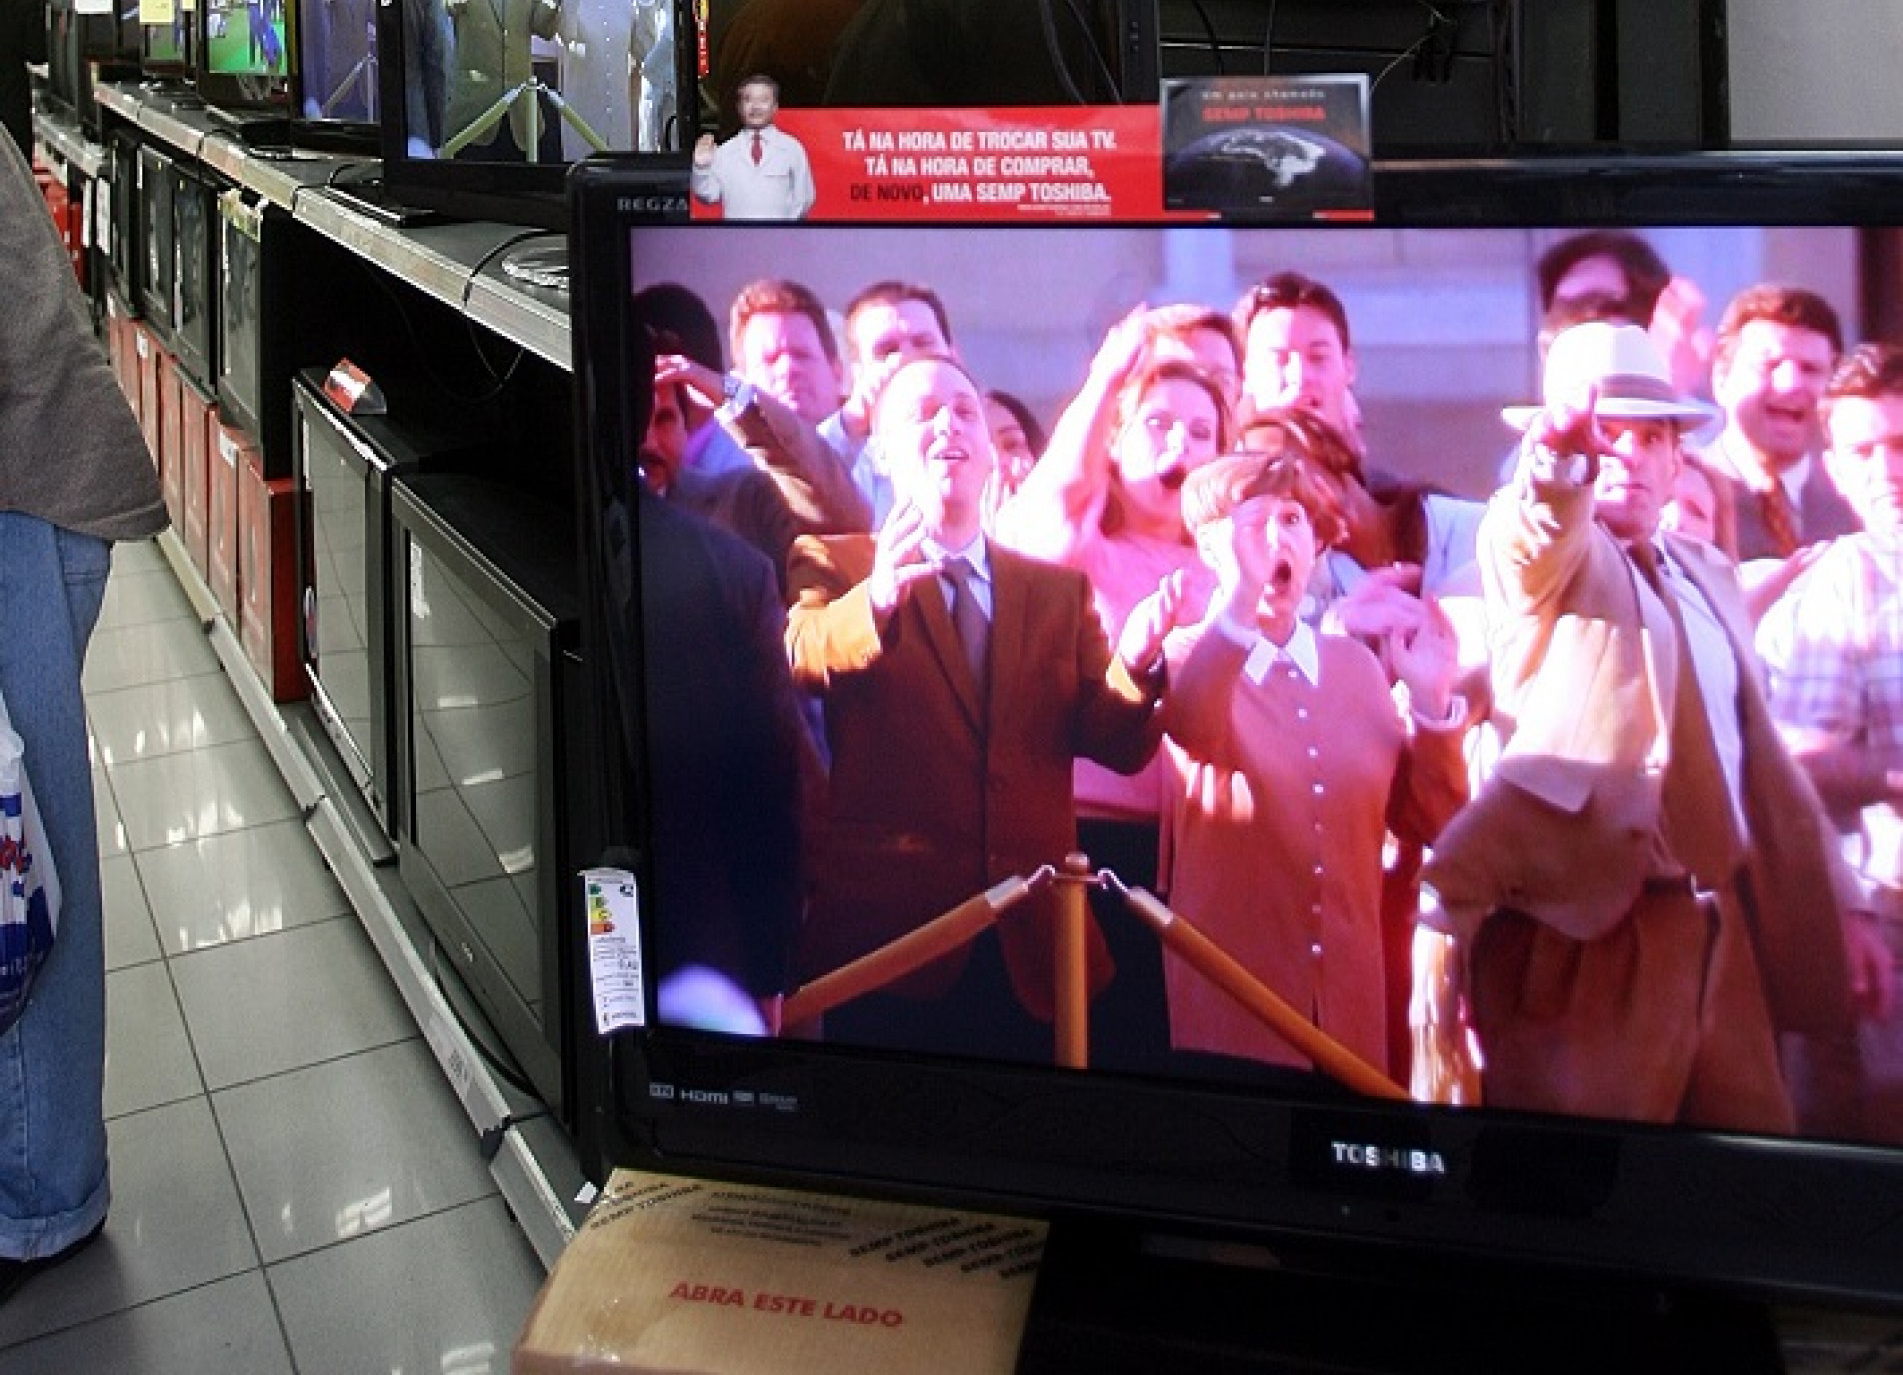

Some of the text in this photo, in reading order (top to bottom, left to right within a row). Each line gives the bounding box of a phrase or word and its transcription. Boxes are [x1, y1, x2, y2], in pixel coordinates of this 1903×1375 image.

[1255, 106, 1326, 121] TOSHIBA
[843, 129, 1117, 152] TÁ NA HORA DE TROCAR SUA TV.
[865, 153, 1096, 179] TÁ NA HORA DE COMPRAR,
[617, 196, 688, 211] REGZA
[850, 182, 872, 201] DE
[931, 182, 973, 203] UMA
[976, 182, 1026, 203] SEMP
[1028, 182, 1112, 203] TOSHIBA.
[1331, 1140, 1445, 1175] TOSHIBA
[669, 1280, 903, 1328] ABRA ESTE LADO
